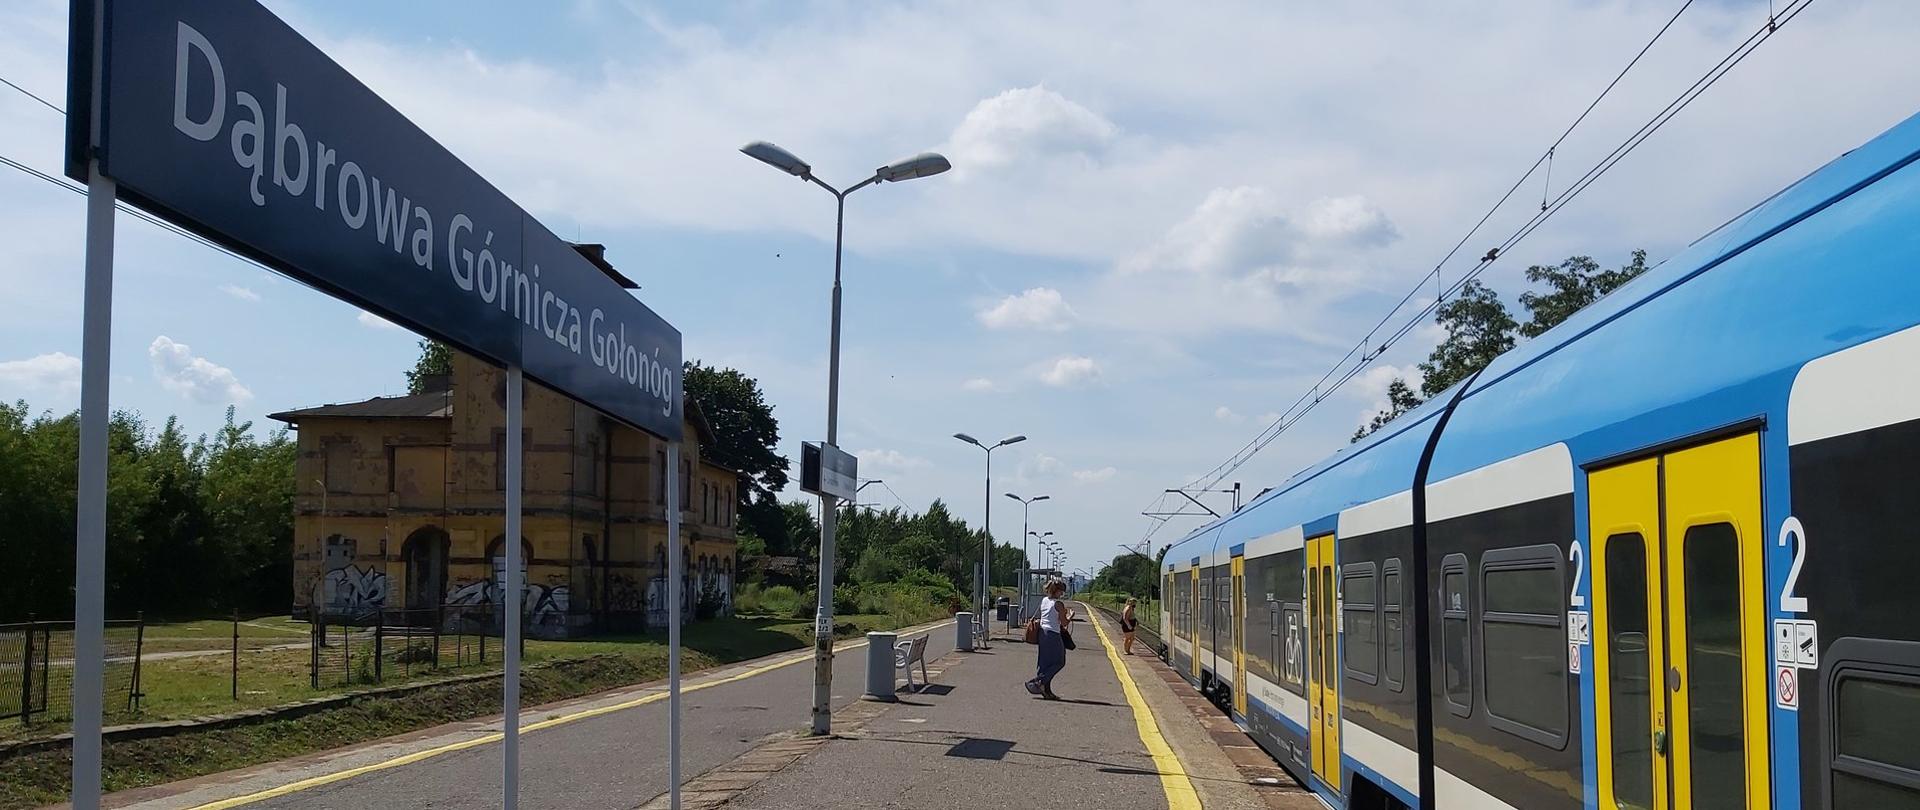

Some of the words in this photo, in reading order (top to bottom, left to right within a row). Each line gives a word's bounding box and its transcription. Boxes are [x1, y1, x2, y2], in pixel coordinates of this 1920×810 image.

[173, 20, 434, 273] Dąbrowa
[447, 213, 582, 355] Górnicza
[589, 308, 673, 417] Gołonóg
[1569, 540, 1585, 606] 2
[1778, 516, 1808, 612] 2
